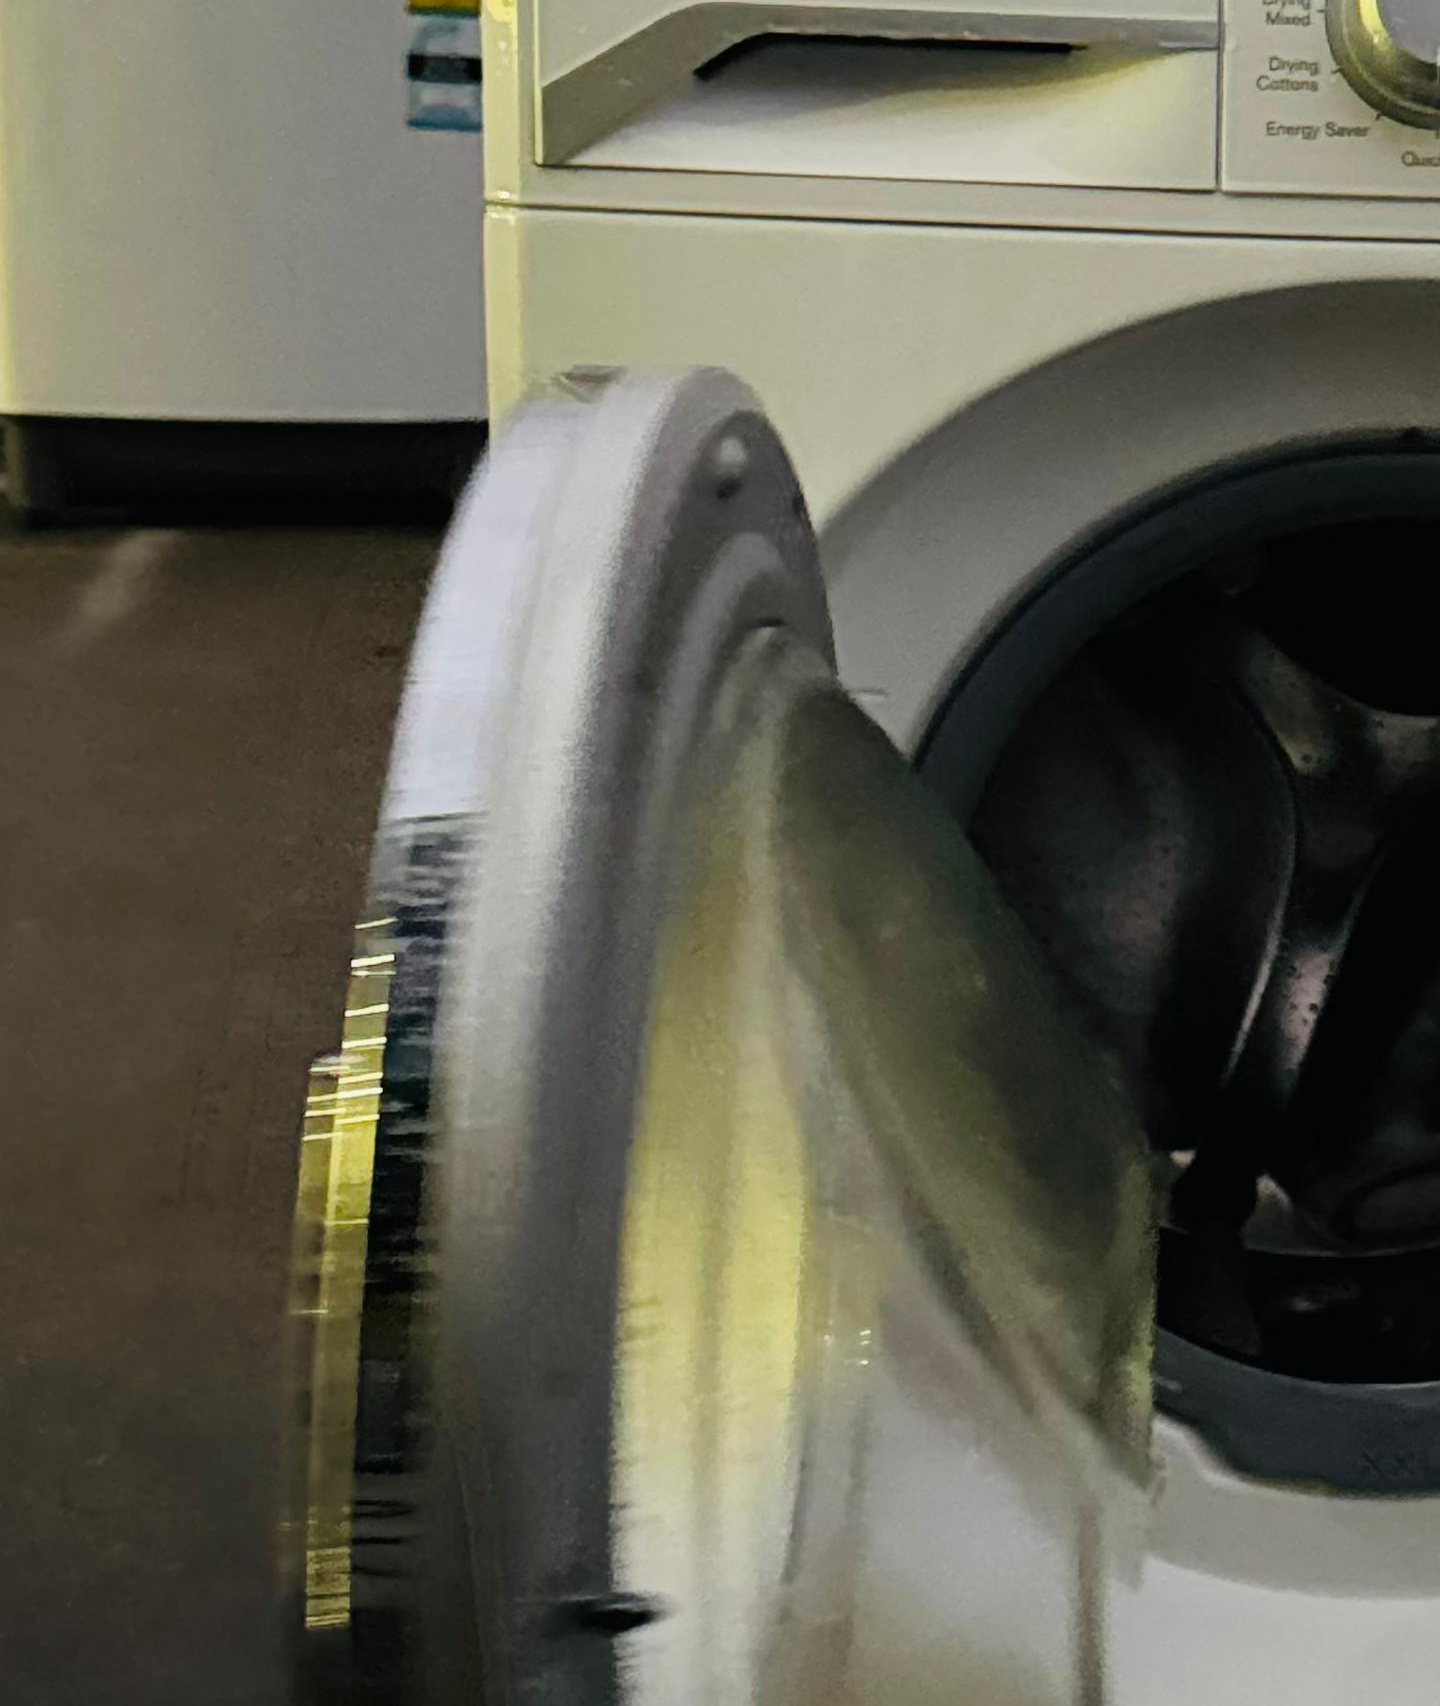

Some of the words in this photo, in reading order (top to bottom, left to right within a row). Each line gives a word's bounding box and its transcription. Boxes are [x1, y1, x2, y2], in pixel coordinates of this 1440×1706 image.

[1265, 11, 1311, 27] Mixed
[1269, 57, 1319, 75] Drying
[1256, 76, 1318, 92] Cottons
[1266, 122, 1320, 139] Energy
[1326, 123, 1370, 138] Saver
